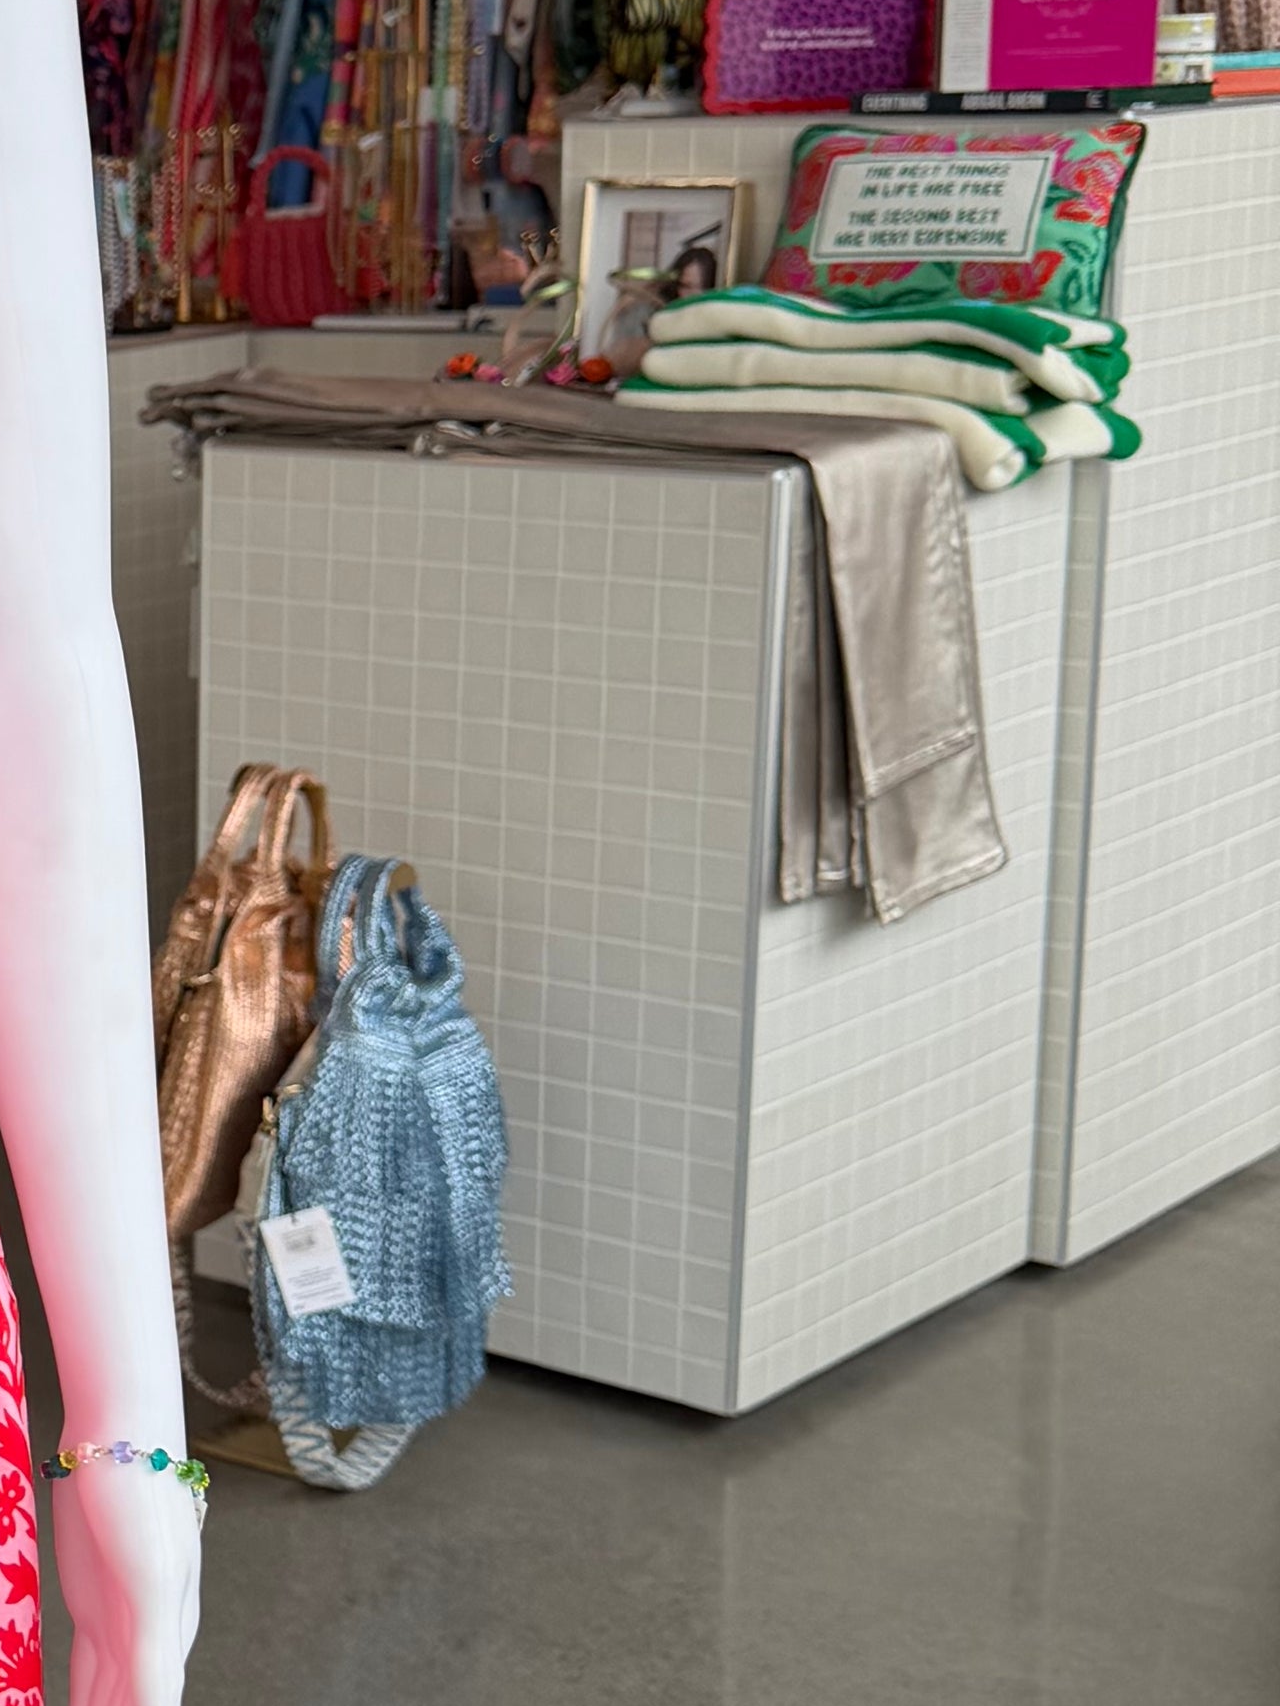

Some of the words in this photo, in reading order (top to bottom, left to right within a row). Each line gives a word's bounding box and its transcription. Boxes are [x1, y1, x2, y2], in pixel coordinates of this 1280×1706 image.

[865, 164, 895, 179] THE
[896, 163, 942, 179] BEST
[946, 162, 1011, 178] THINGS
[858, 182, 879, 199] IN
[881, 181, 919, 198] LIFE
[921, 181, 955, 197] ARE
[958, 180, 1006, 197] FREE
[847, 208, 876, 225] THE
[881, 206, 952, 224] SECOND
[955, 206, 1001, 223] BEST
[833, 229, 865, 246] ARE
[868, 228, 909, 246] VERY
[913, 227, 1008, 246] EXPENSIVE
